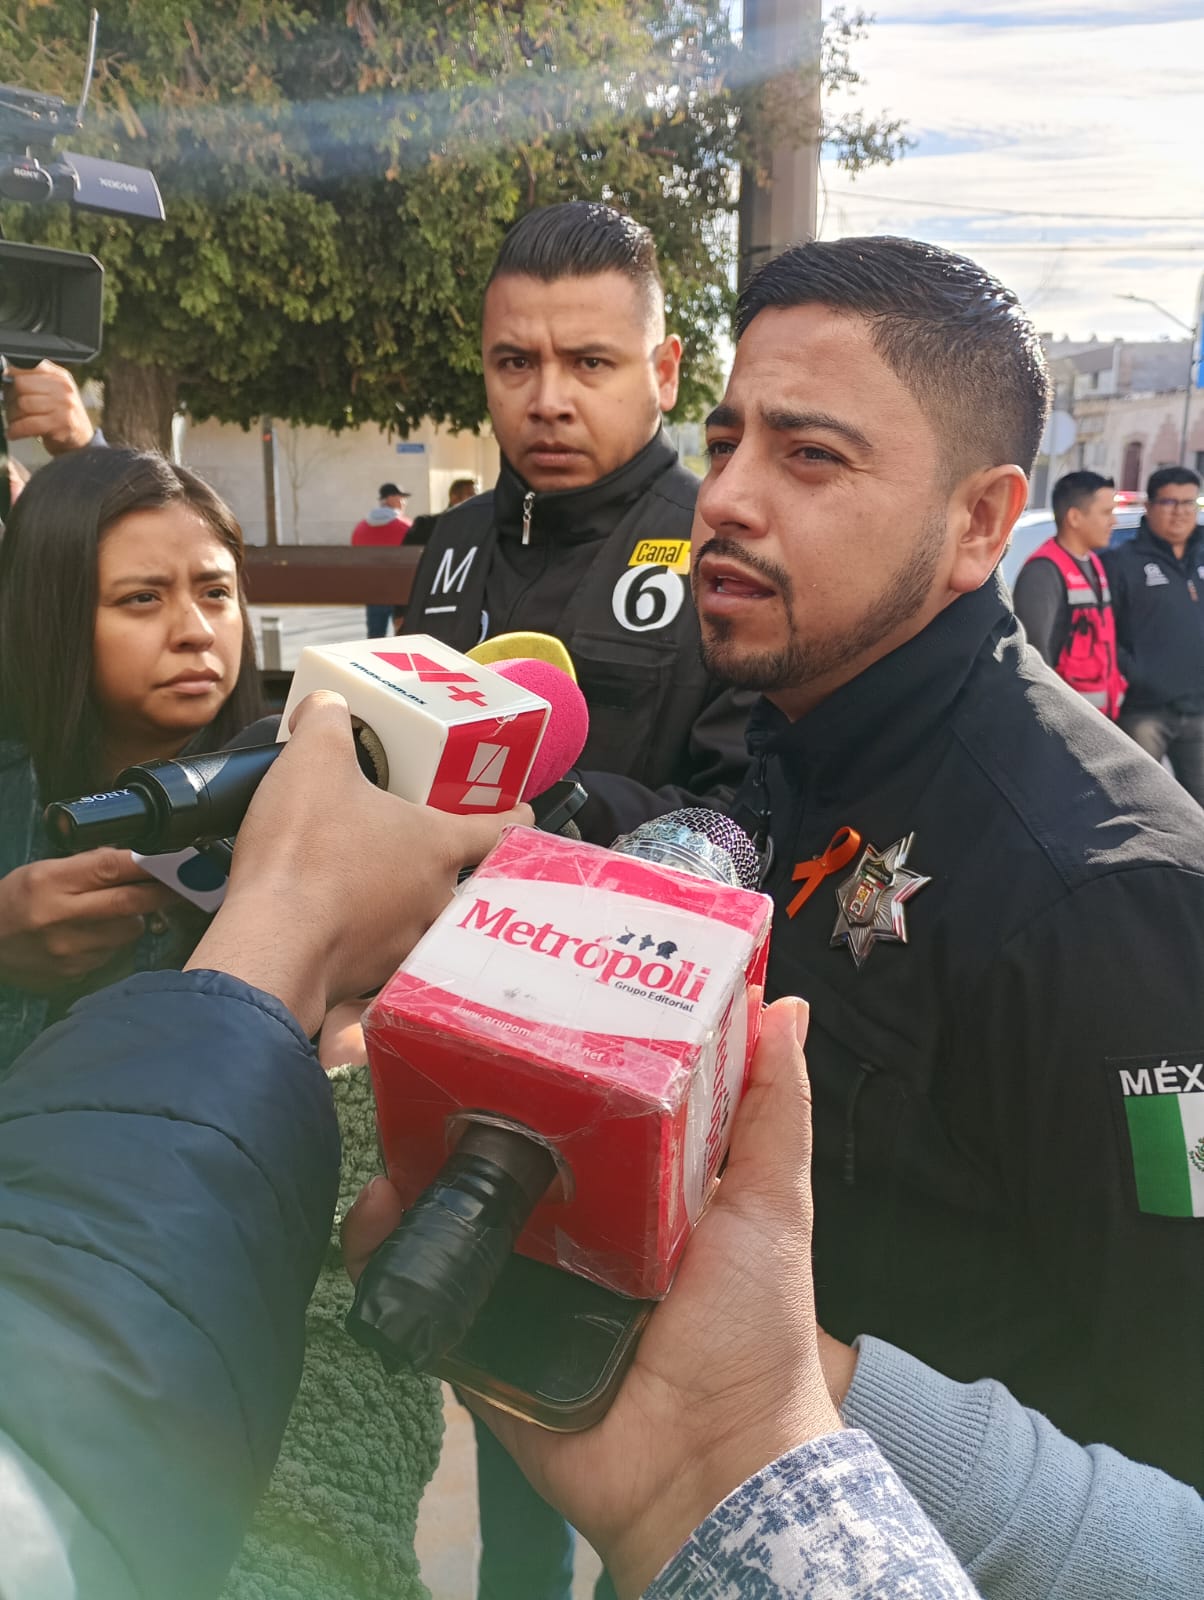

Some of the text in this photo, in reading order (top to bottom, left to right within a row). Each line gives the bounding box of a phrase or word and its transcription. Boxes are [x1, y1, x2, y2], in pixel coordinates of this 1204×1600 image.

[431, 546, 478, 595] M
[636, 541, 684, 563] Canal
[625, 565, 668, 627] 6
[350, 661, 428, 705] nmas.com.mx
[80, 788, 131, 804] SONY
[456, 898, 712, 1003] Metrópoli
[615, 981, 694, 1013] Grupo Editorial
